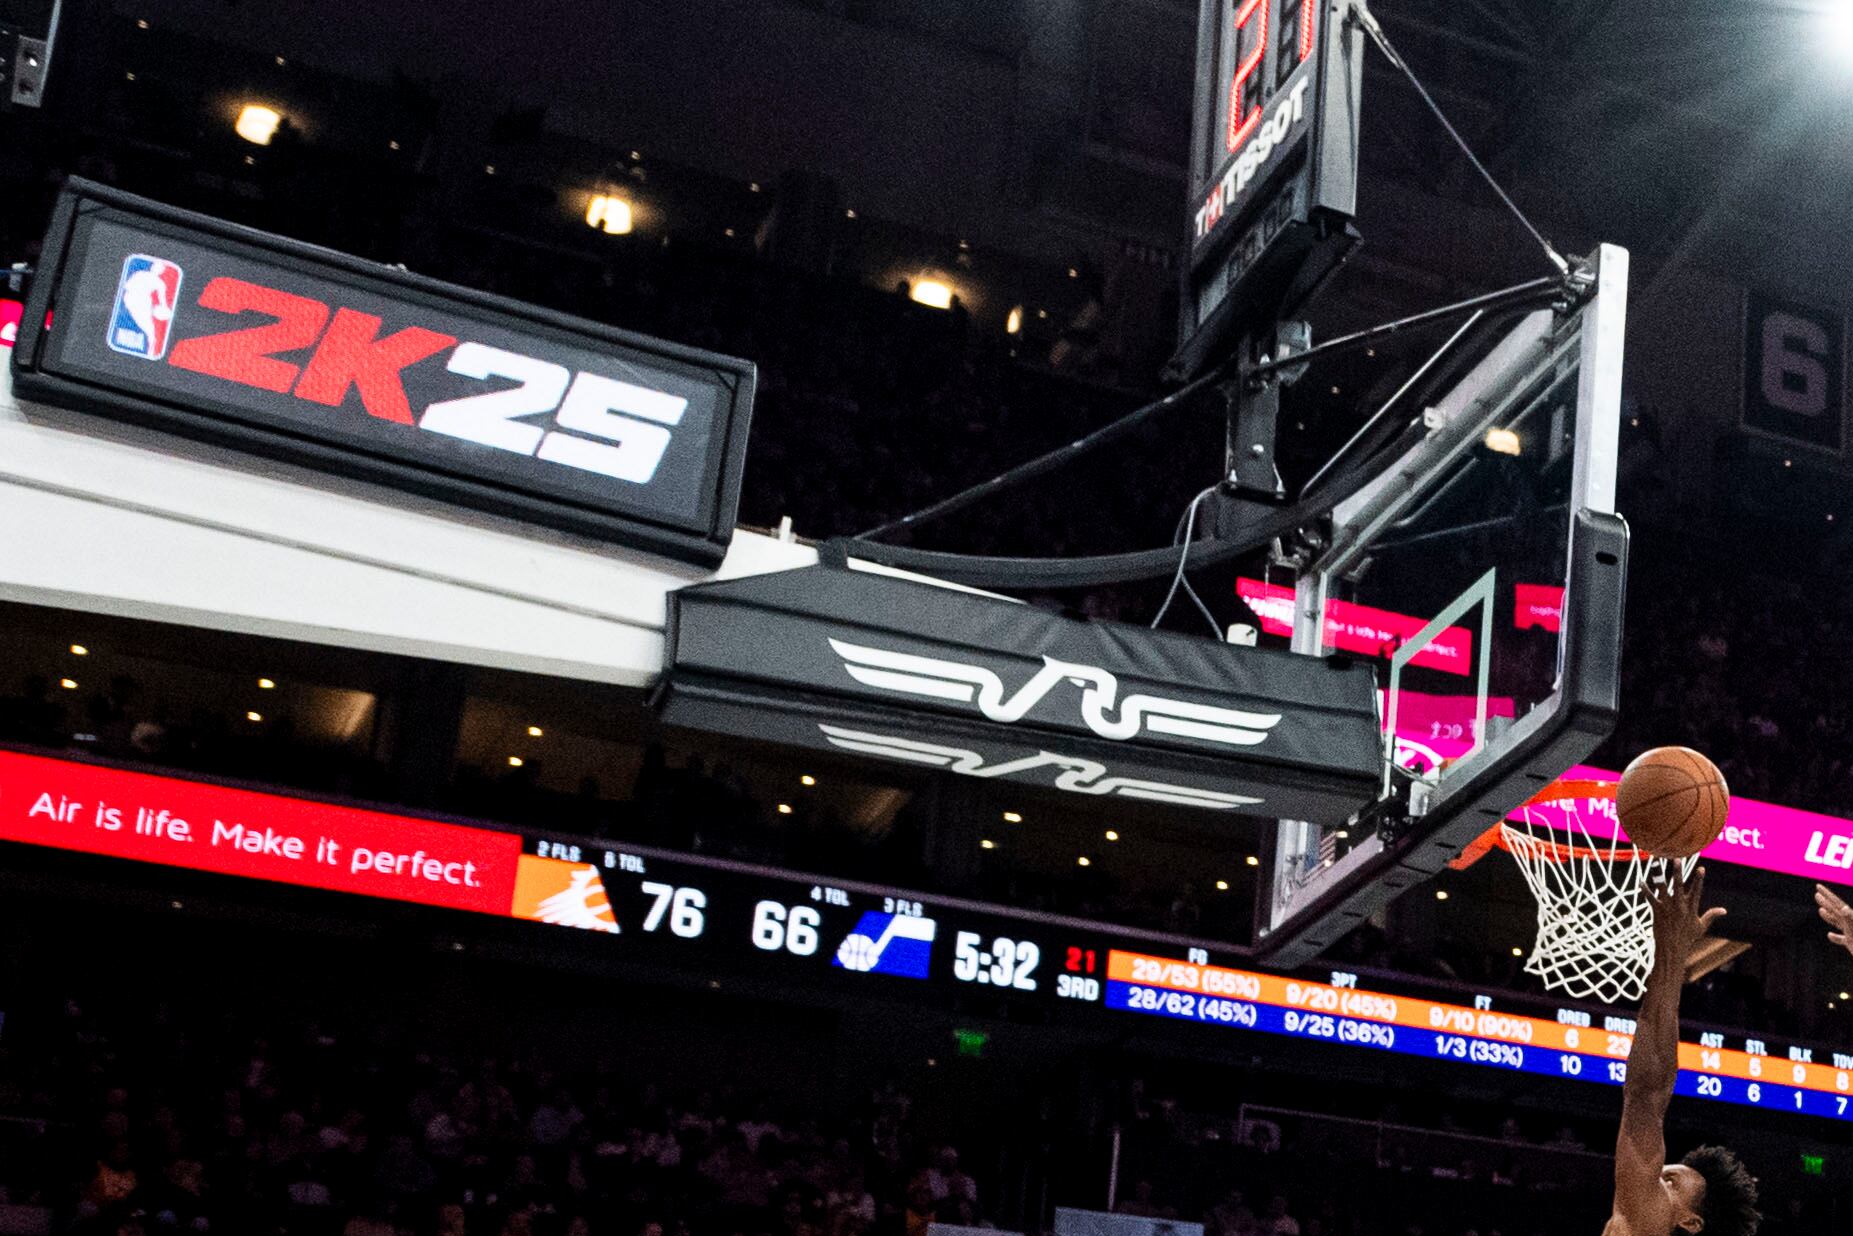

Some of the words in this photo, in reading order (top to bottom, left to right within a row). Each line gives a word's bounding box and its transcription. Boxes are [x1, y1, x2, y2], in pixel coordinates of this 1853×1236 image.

[1220, 75, 1309, 206] TISSOT
[167, 277, 689, 486] 2K25
[1761, 311, 1829, 417] 6
[29, 792, 83, 824] Air
[95, 800, 122, 831] is
[136, 806, 193, 842] life.
[211, 820, 305, 859] Make
[317, 836, 339, 865] it
[350, 846, 482, 888] perfect.
[538, 840, 550, 858] 2
[641, 881, 707, 939] 76
[752, 900, 821, 956] 66
[954, 930, 1040, 991] 5:32
[1065, 946, 1096, 973] 21
[1056, 974, 1099, 1001] 3RD
[1286, 983, 1338, 1011] 9/20
[1341, 990, 1398, 1022] (45%)
[1429, 1006, 1475, 1033] 9/10
[1701, 1051, 1720, 1070] 14
[1475, 994, 1492, 1012] FT
[1128, 986, 1194, 1016] 28/62
[1198, 997, 1257, 1028] (45%)
[1284, 1011, 1335, 1037] 9/25
[1337, 1018, 1395, 1049] (36%)
[1435, 1035, 1467, 1058] 1/3
[1470, 1041, 1524, 1069] (33%)
[1560, 1055, 1582, 1076] 10
[1697, 1076, 1722, 1096] 20
[1747, 1084, 1761, 1103] 6
[1795, 1091, 1802, 1109] 1
[1837, 1098, 1848, 1115] 7
[1700, 1032, 1724, 1049] AST
[1745, 1039, 1767, 1057] STL
